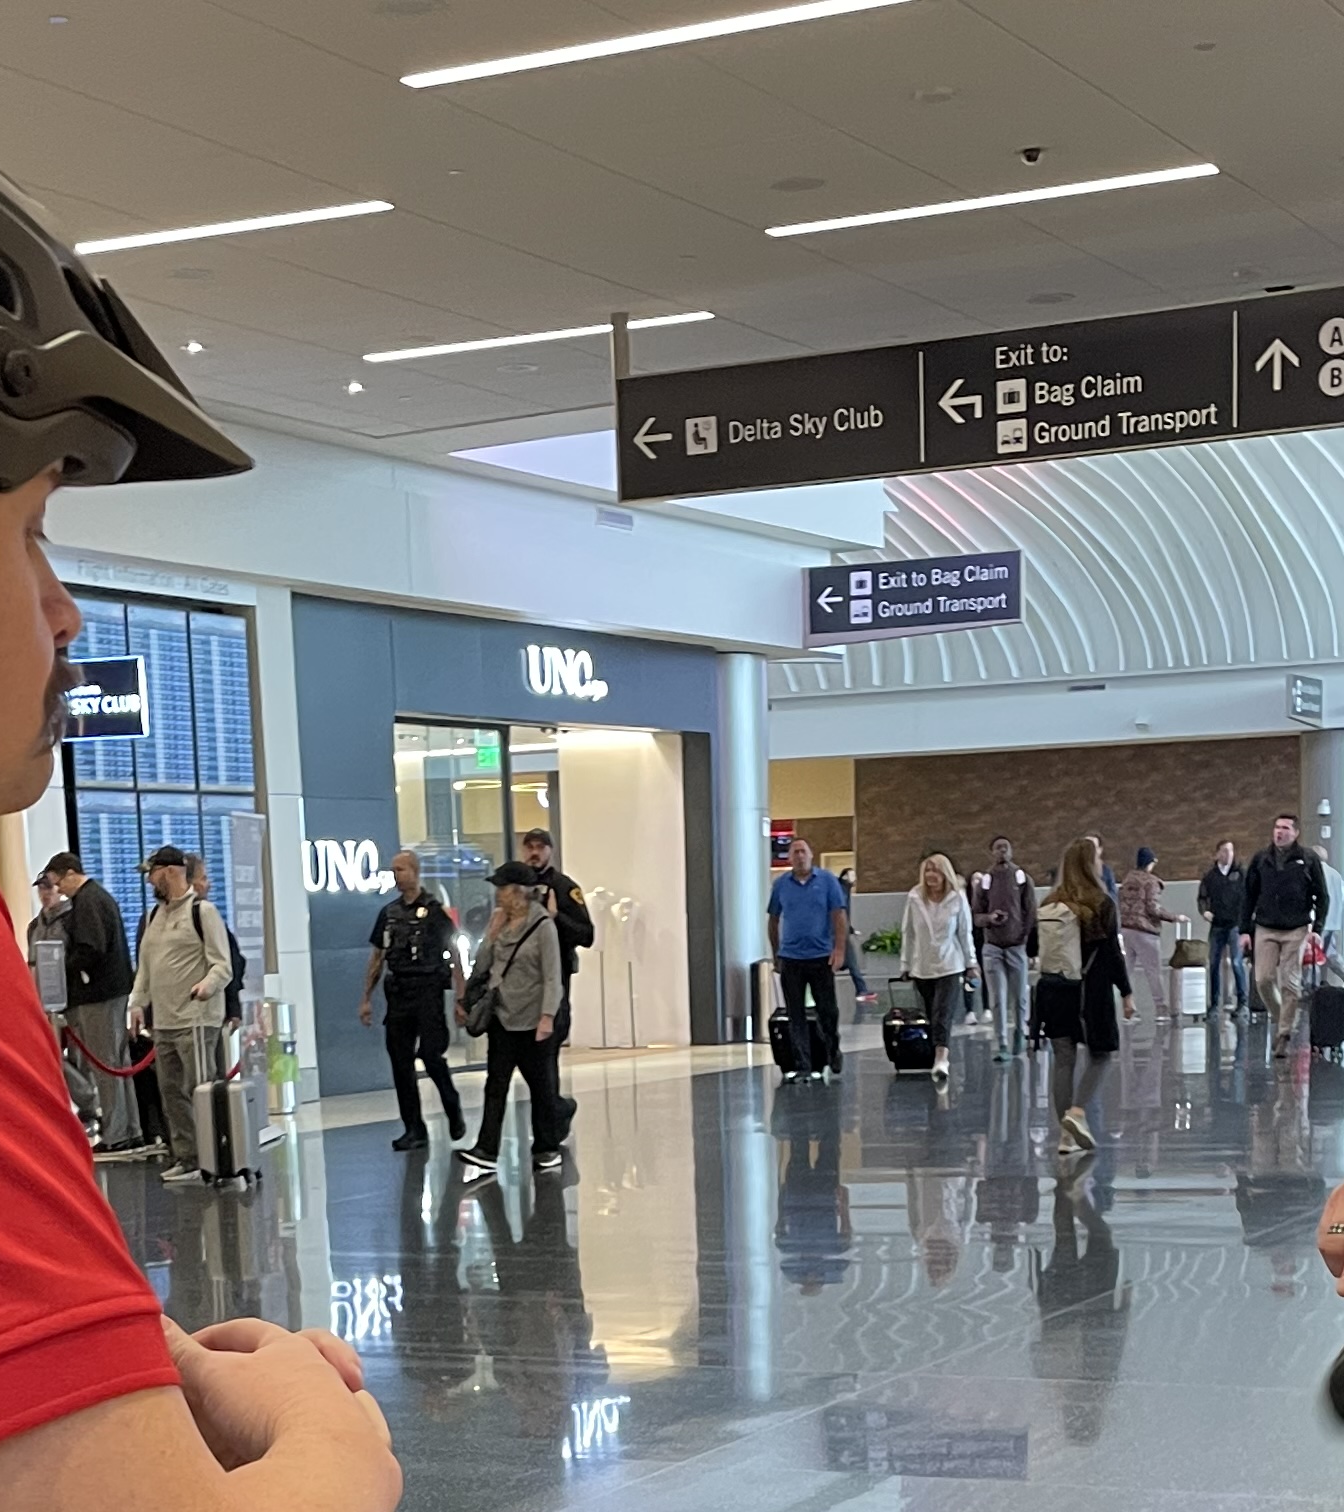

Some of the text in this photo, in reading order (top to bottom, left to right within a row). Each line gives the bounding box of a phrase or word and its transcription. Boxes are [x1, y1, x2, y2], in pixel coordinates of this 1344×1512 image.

[994, 342, 1069, 369] Exit to:
[1033, 371, 1143, 406] Bag Claim
[728, 404, 884, 444] Delta Sky Club
[1032, 402, 1219, 444] Ground Transport
[877, 563, 1009, 590] Exit to Bag Claim
[876, 592, 1008, 619] Ground Transport
